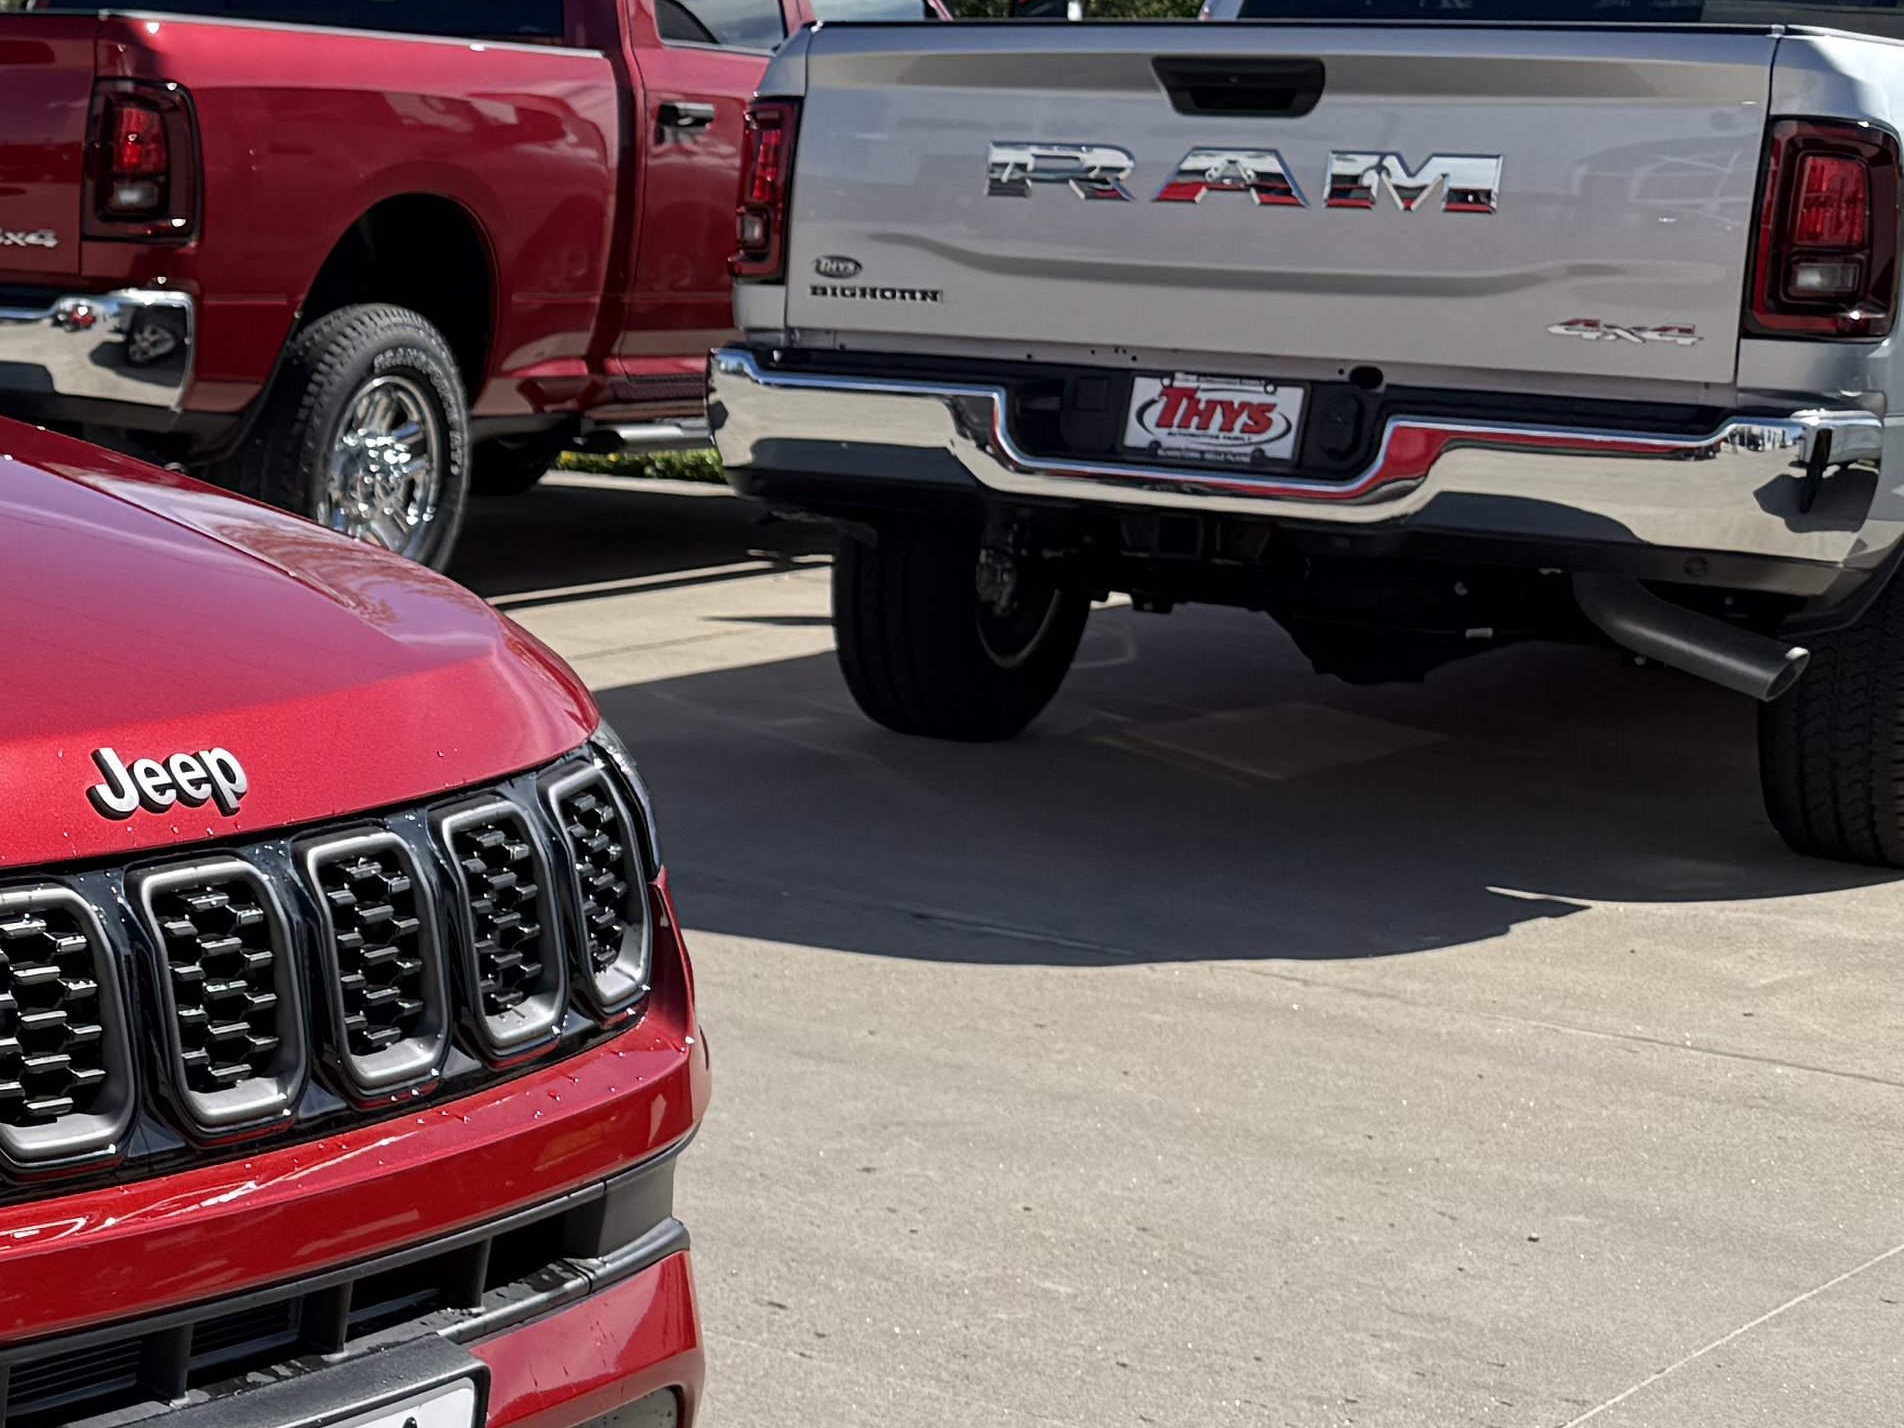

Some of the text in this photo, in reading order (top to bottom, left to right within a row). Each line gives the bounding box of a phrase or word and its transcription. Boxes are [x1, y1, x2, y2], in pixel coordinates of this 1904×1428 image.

[983, 139, 1505, 215] RAM
[1547, 318, 1704, 346] 4x4
[1155, 386, 1278, 435] THYS
[86, 745, 249, 820] Jeep
